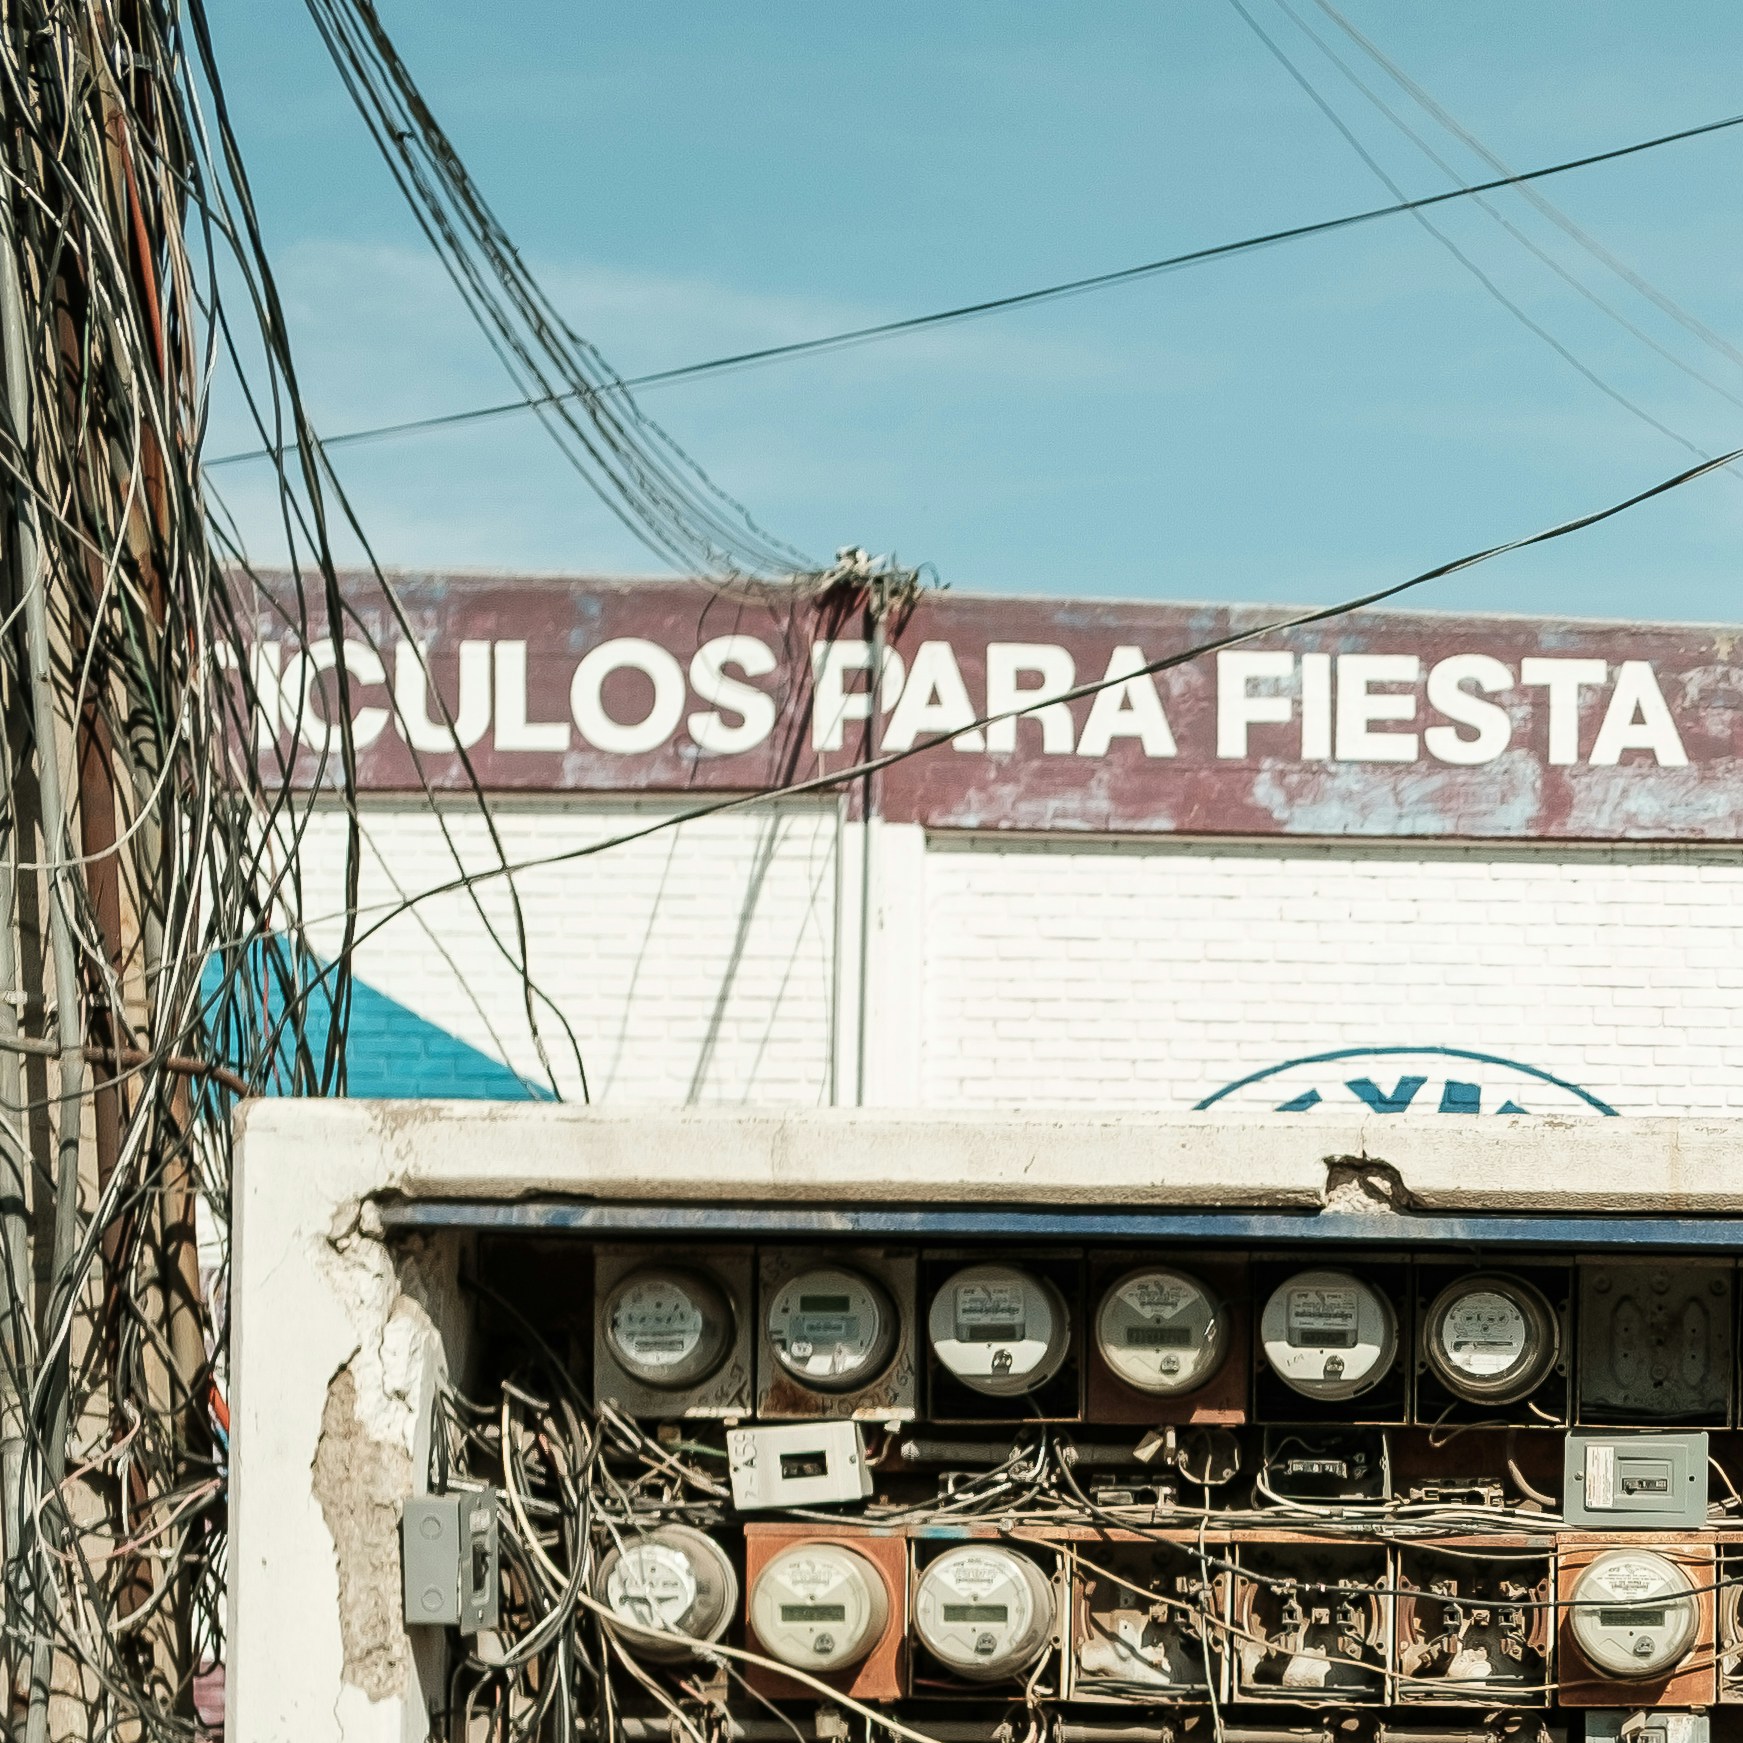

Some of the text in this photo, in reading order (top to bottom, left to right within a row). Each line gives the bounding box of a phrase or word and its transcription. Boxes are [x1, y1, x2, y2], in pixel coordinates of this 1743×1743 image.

[213, 636, 1690, 768] ICULOS PARA FIESTA
